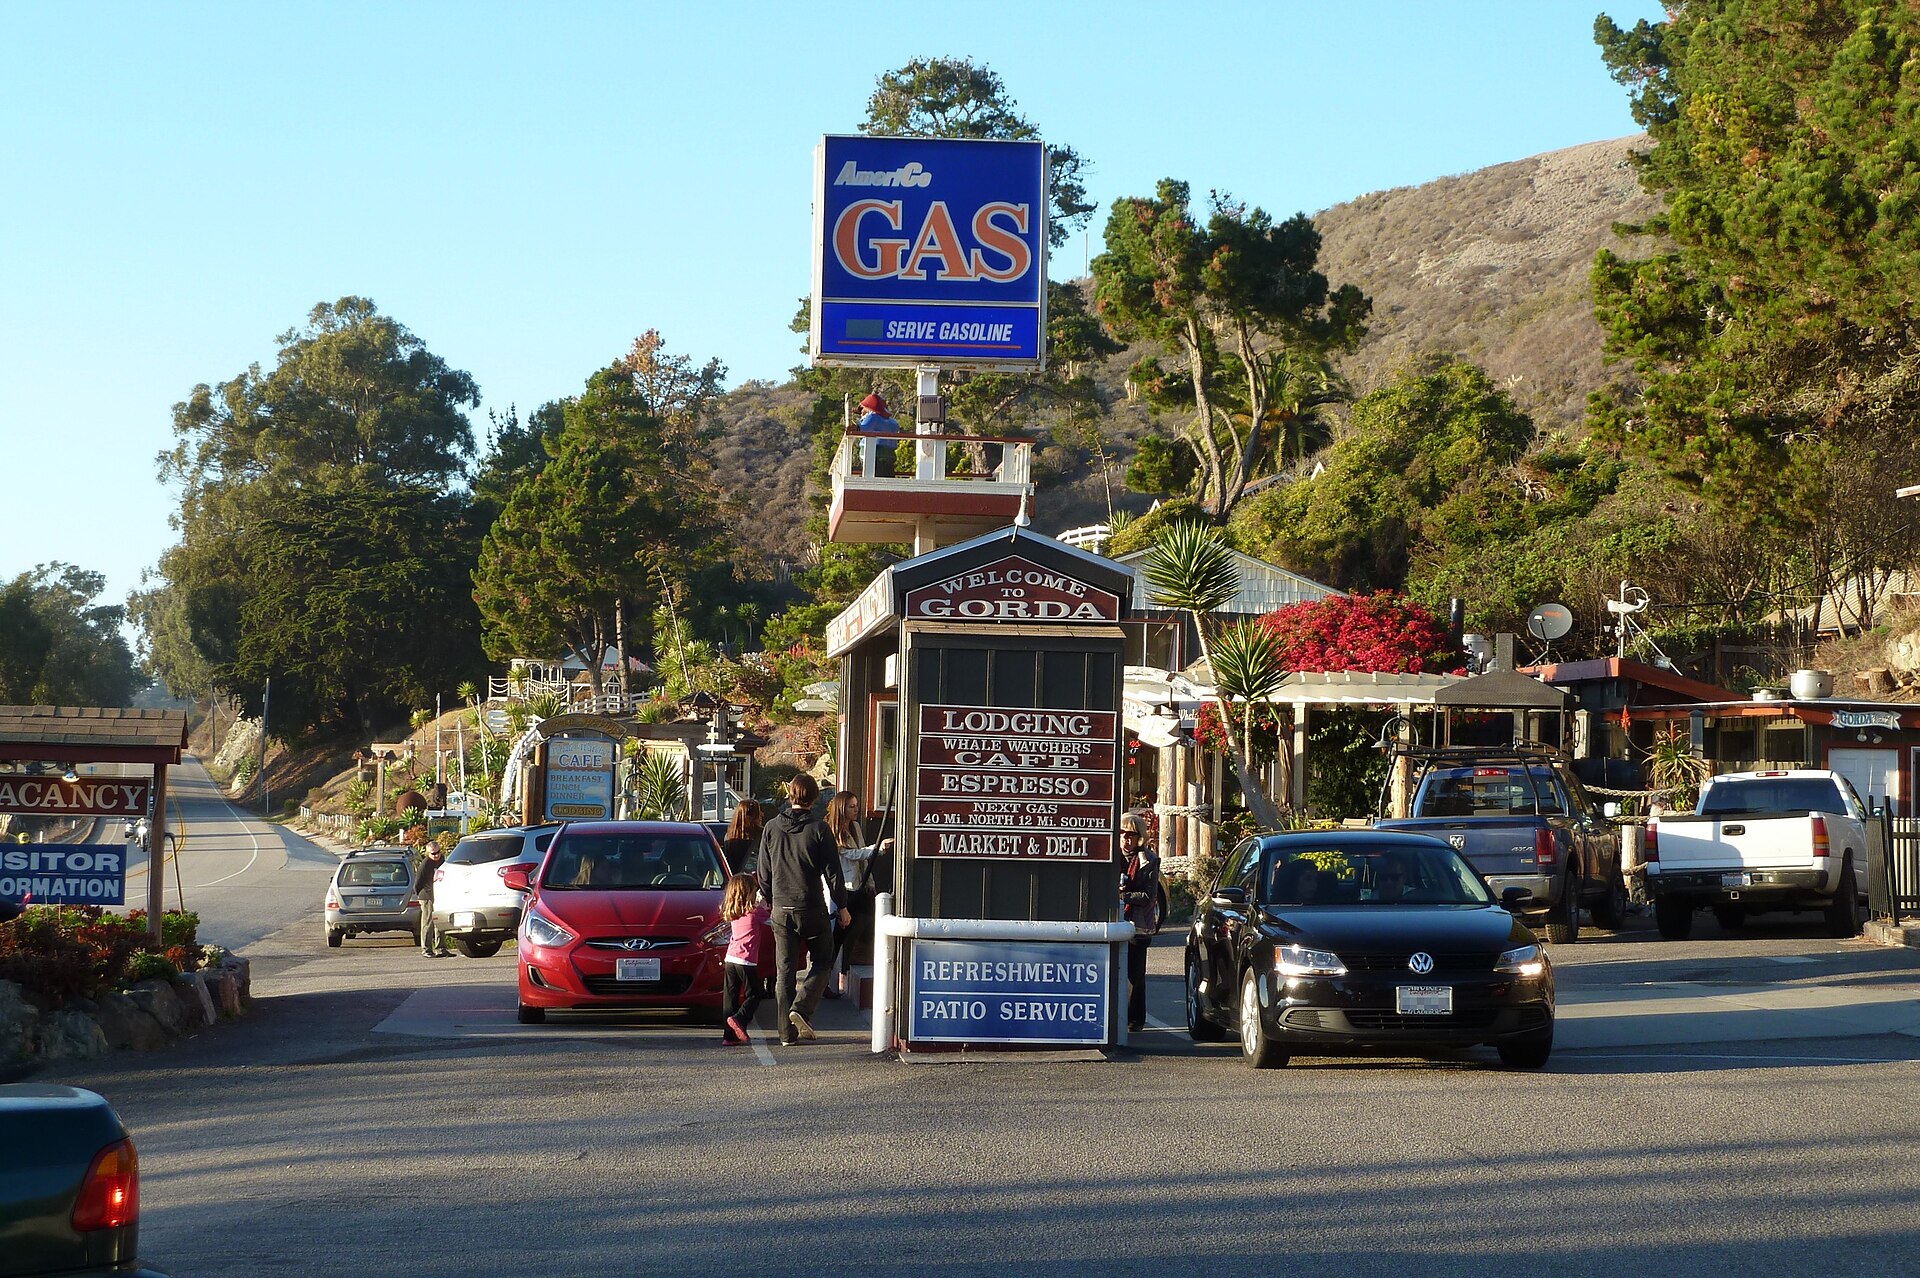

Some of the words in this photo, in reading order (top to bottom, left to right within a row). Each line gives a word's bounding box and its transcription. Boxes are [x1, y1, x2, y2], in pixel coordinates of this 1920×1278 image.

[834, 160, 932, 188] AmeriCo
[832, 199, 1032, 283] GAS
[886, 320, 935, 340] SERVE
[938, 321, 1013, 342] GASOLINE
[939, 569, 1088, 599] WELCOME
[1000, 587, 1025, 598] TO
[919, 600, 1106, 620] GORDA
[943, 710, 1092, 736] LODGING
[1840, 712, 1873, 725] GORDA
[943, 738, 1001, 751] WHALE
[1007, 740, 1091, 755] WATCHERS
[559, 753, 603, 768] CAFE
[954, 751, 1080, 769] CAFE
[550, 783, 580, 791] LUNCH
[940, 773, 1090, 797] ESPRESSO
[0, 782, 145, 810] ACANCY
[550, 792, 585, 800] DINNER
[554, 805, 603, 816] LODGING
[973, 802, 1020, 814] NEXT
[1026, 804, 1058, 815] GAS
[923, 813, 940, 824] 40
[943, 814, 964, 825] Mi.
[968, 814, 1014, 826] NORTH
[1018, 815, 1032, 827] 12
[1037, 816, 1057, 827] Mi.
[1060, 817, 1106, 829] SOUTH
[938, 833, 1023, 856] MARKET
[1027, 837, 1041, 856] &
[1045, 836, 1088, 857] DELI
[922, 960, 1098, 984] REFRESHMENTS
[921, 1000, 987, 1021] PATIO
[999, 1001, 1098, 1022] SERVICE
